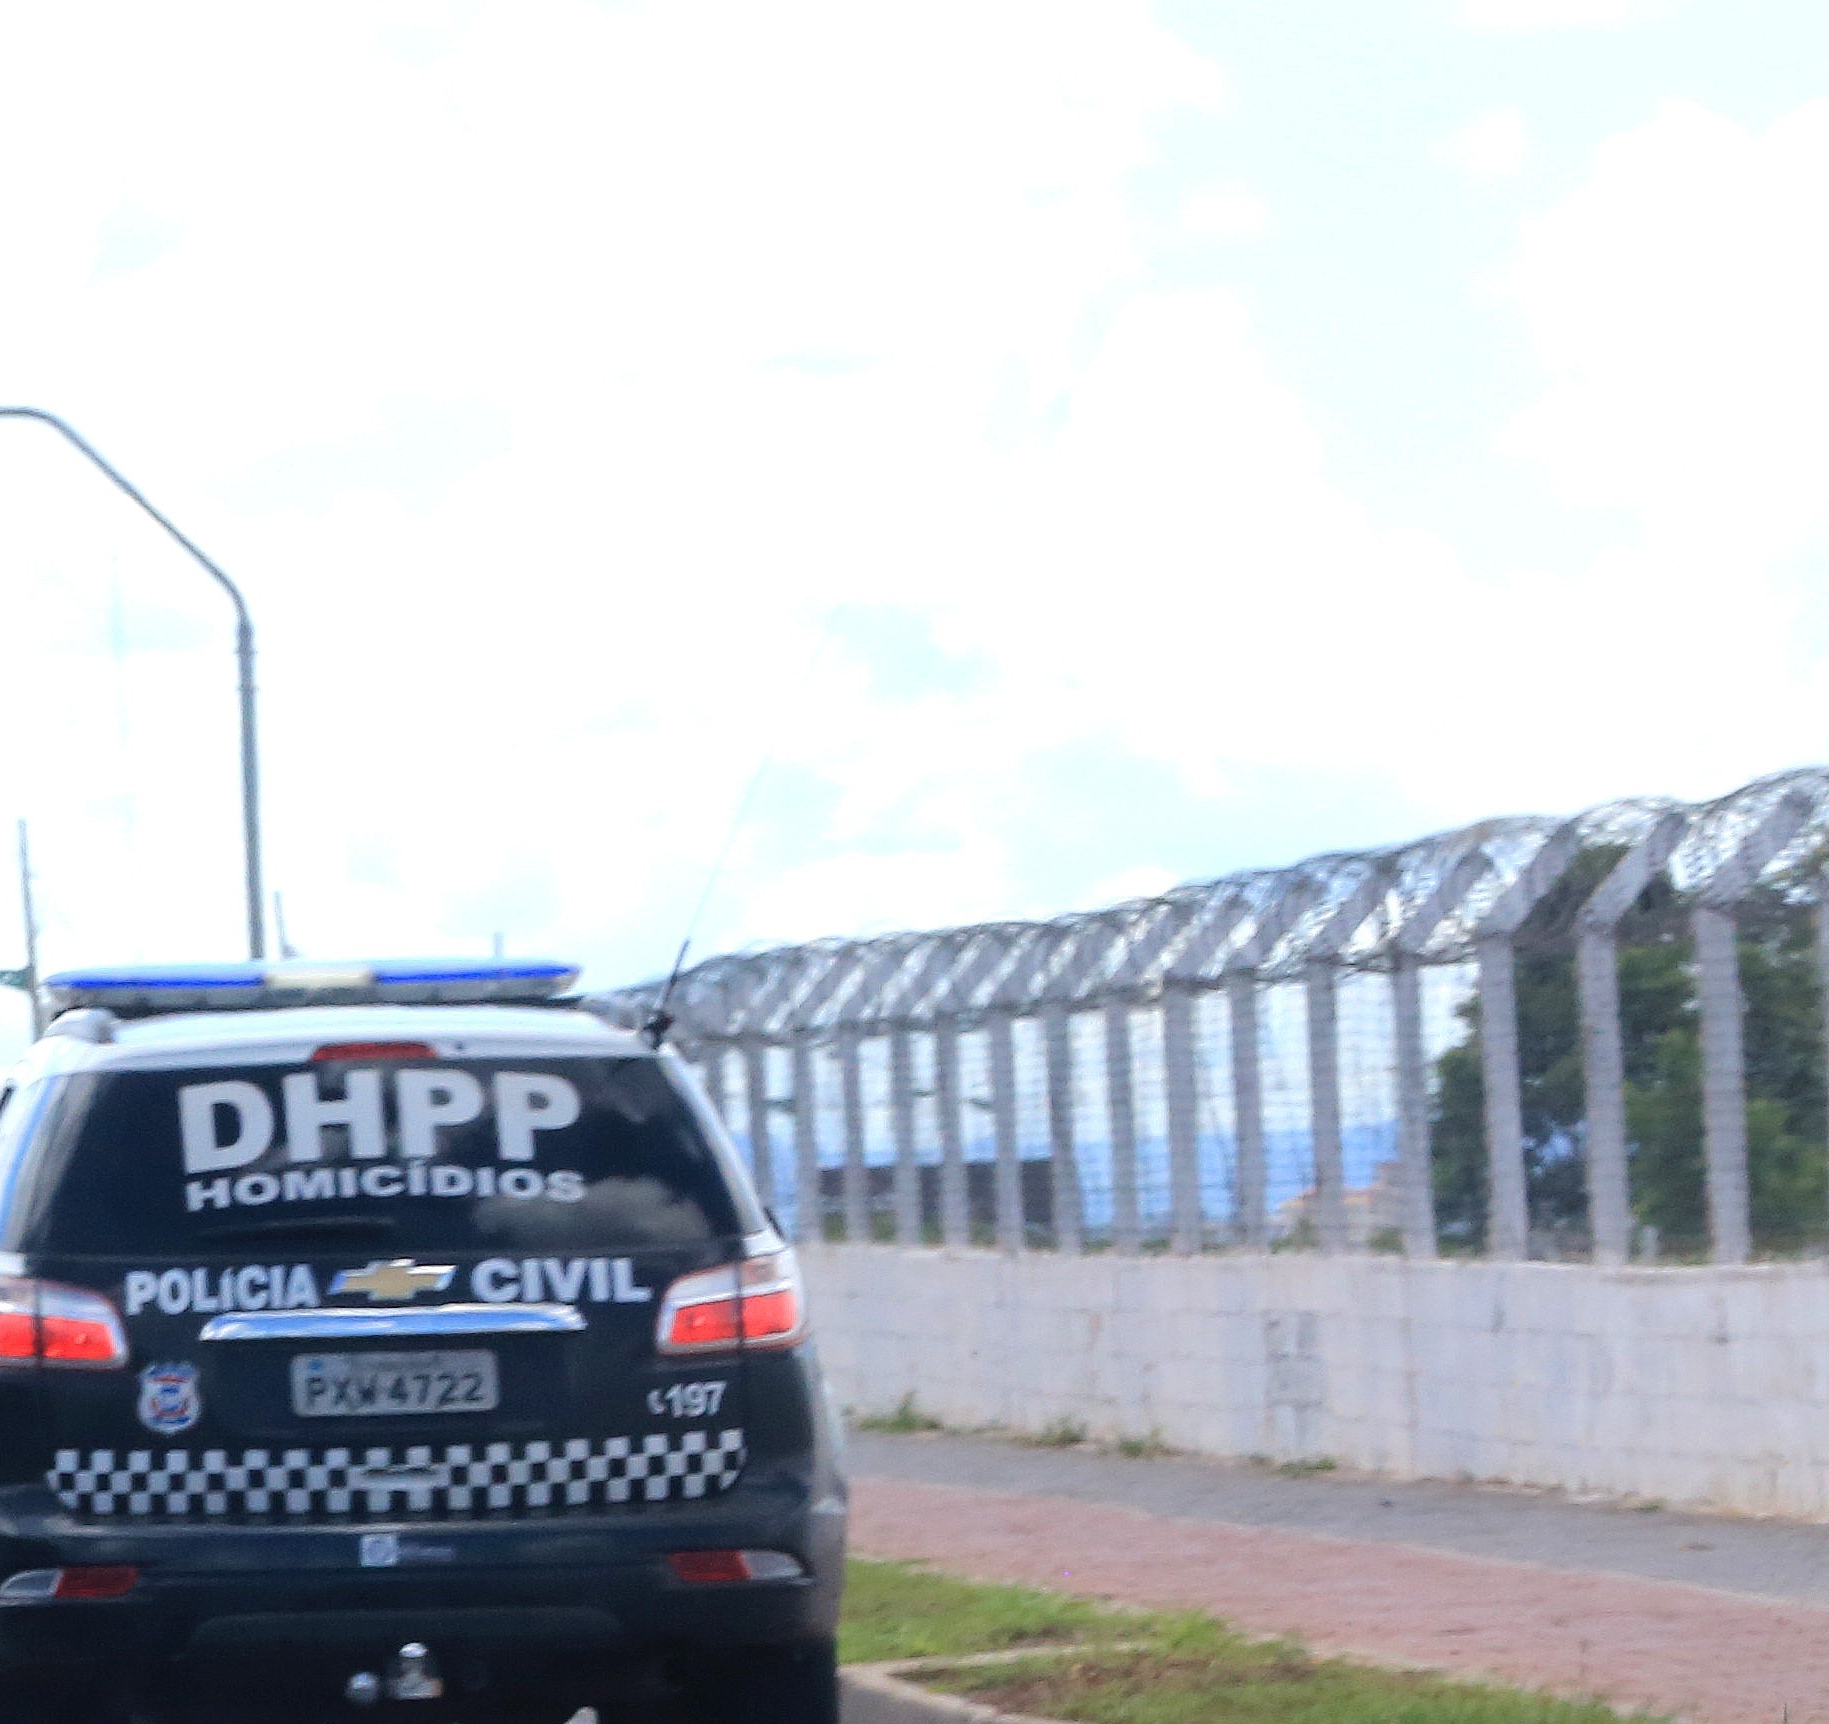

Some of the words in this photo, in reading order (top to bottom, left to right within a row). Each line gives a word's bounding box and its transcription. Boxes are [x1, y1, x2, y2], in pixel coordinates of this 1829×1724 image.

[178, 1068, 581, 1175] DHPP
[185, 1160, 588, 1213] HOMICÍDIOS
[124, 1262, 322, 1316] POLÍCIA
[470, 1257, 653, 1304] CIVIL
[664, 1381, 728, 1418] 197
